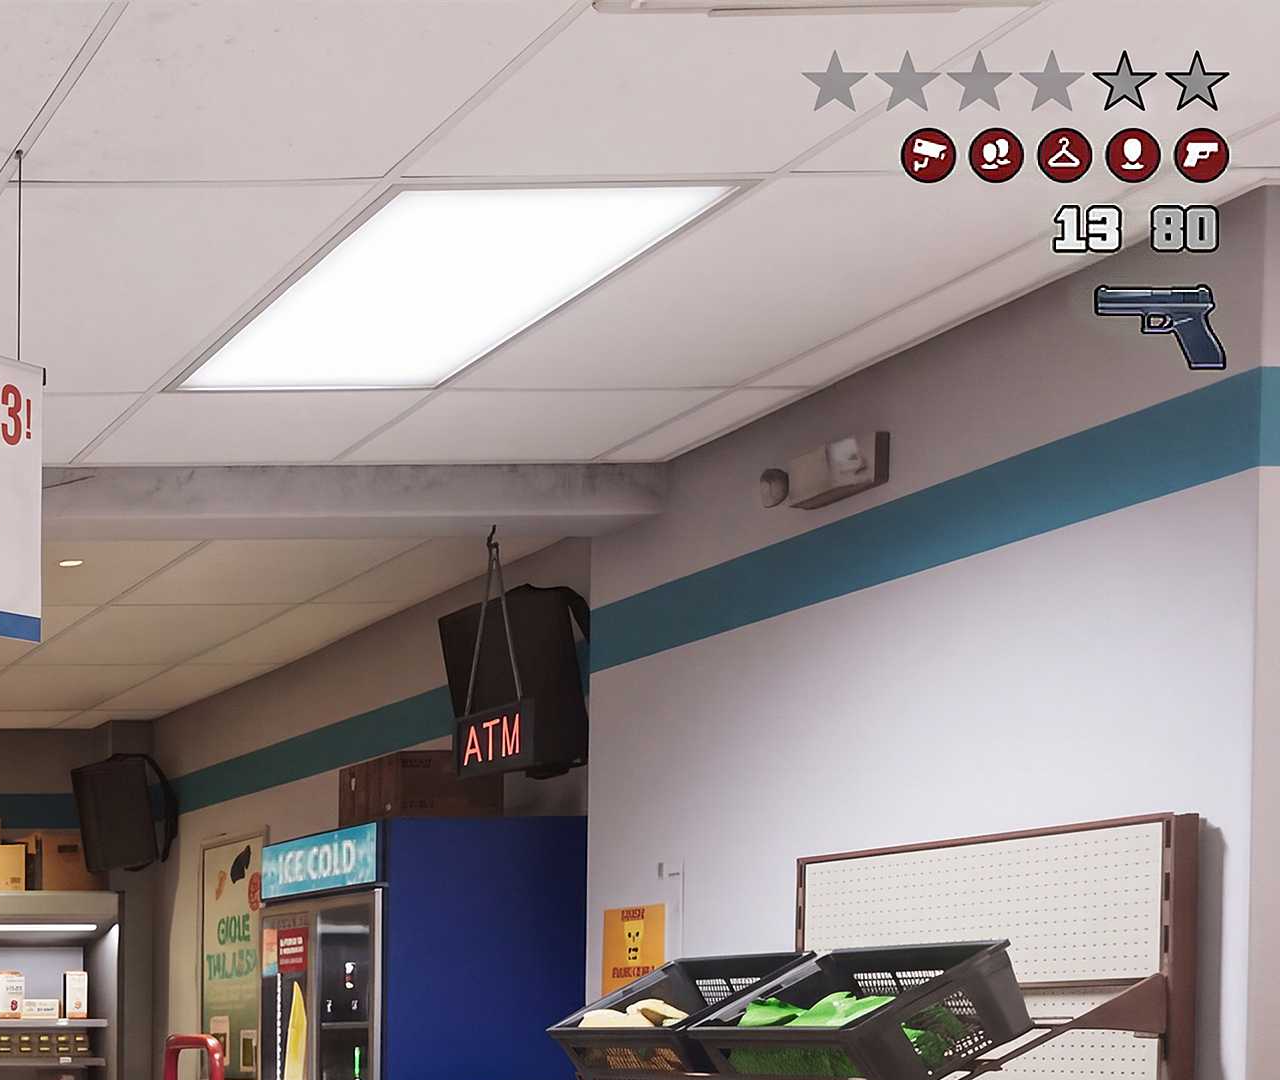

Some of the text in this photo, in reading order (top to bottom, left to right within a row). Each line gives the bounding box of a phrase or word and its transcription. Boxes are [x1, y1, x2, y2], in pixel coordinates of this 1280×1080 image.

[463, 713, 521, 766] ATM
[278, 839, 356, 884] ICE COLD
